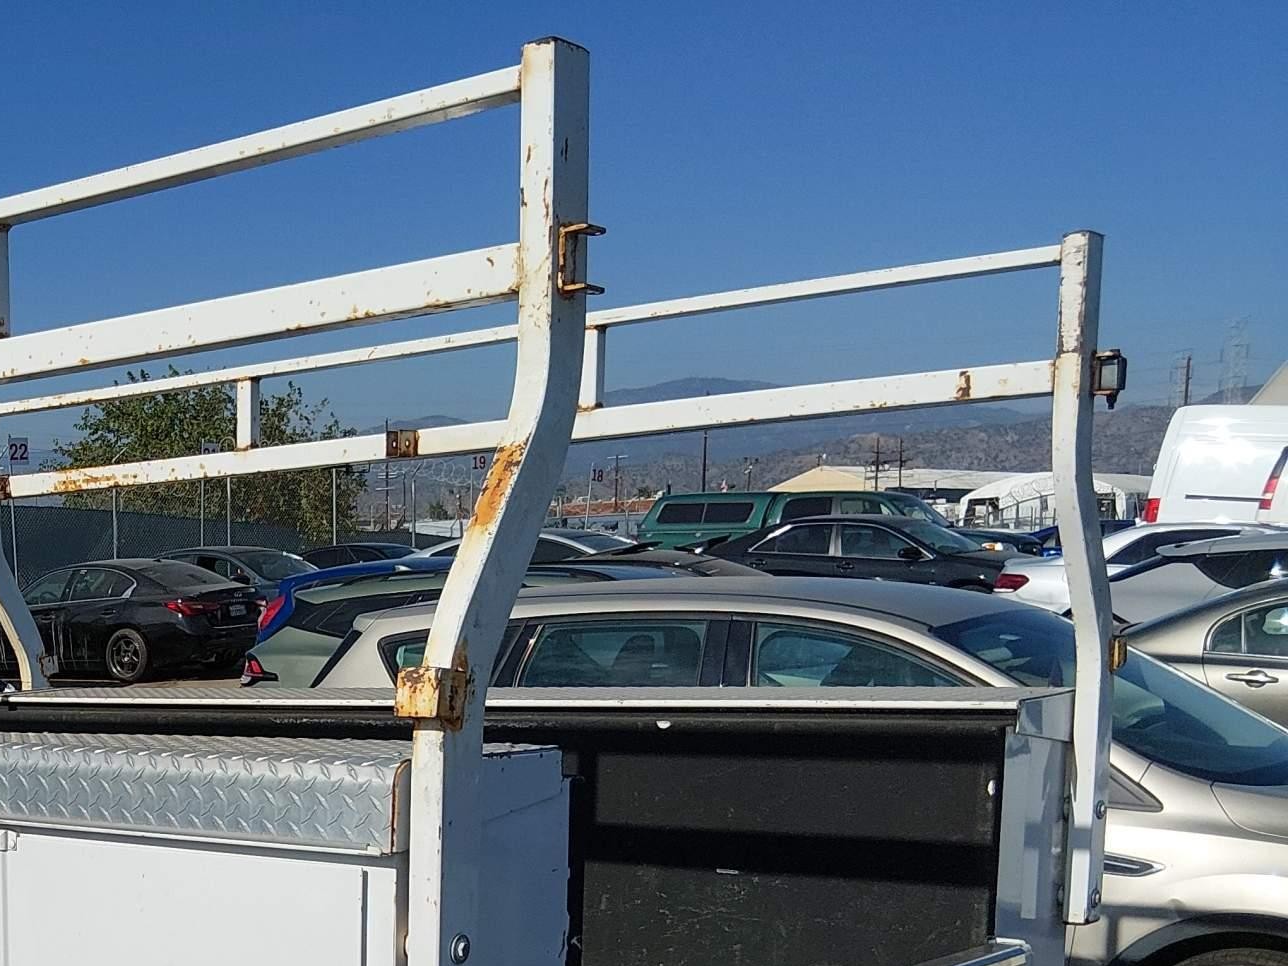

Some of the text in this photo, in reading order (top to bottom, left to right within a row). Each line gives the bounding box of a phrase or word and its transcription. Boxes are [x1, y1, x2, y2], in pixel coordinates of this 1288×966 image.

[9, 443, 29, 461] 22
[472, 456, 486, 470] 19
[592, 468, 604, 482] 18
